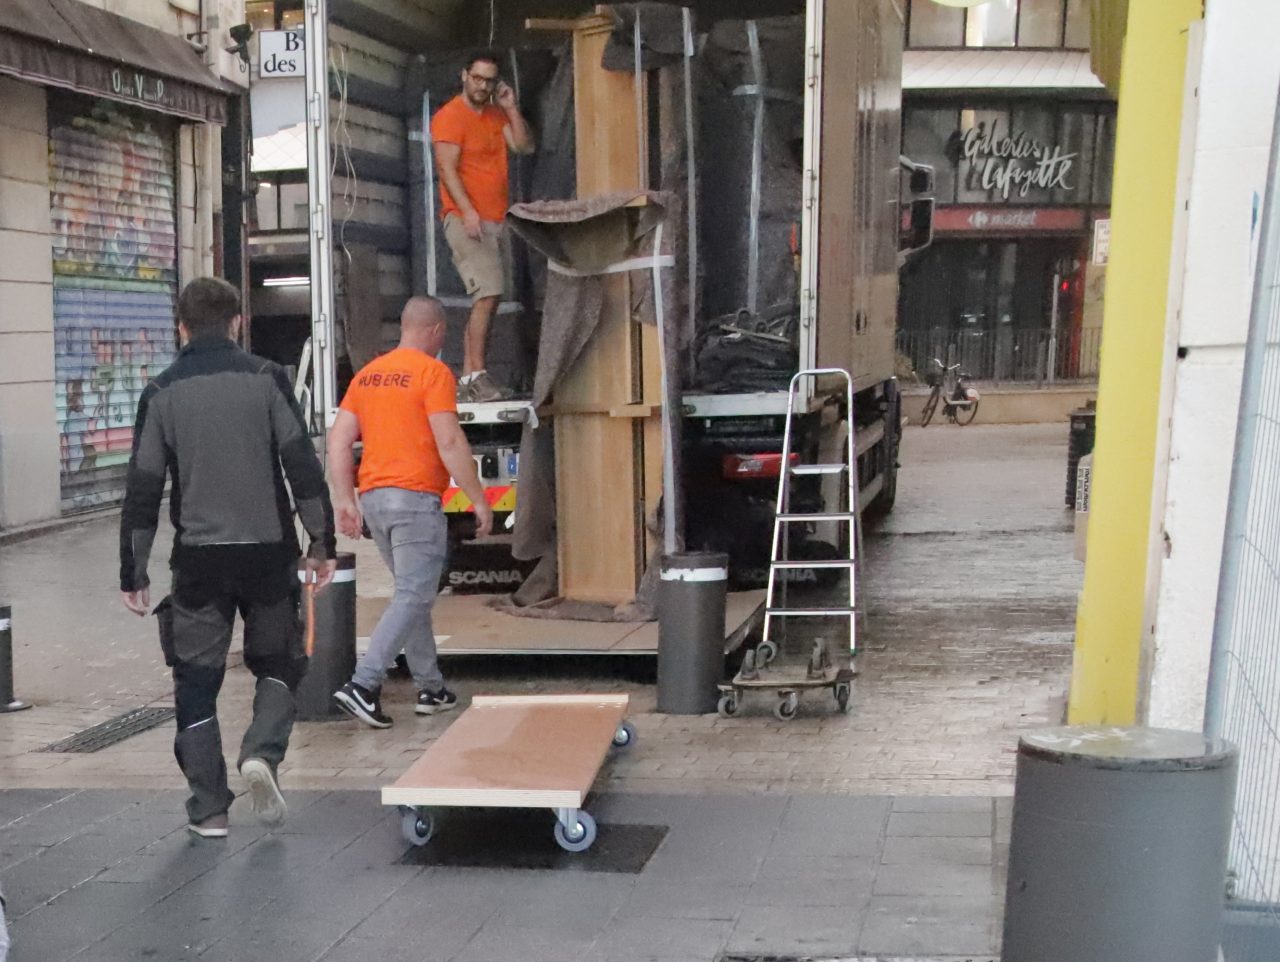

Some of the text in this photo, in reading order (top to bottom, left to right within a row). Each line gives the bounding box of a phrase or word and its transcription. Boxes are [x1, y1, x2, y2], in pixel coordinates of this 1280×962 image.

[264, 53, 296, 73] des
[982, 146, 1078, 199] Lafayette
[991, 211, 1038, 226] market
[448, 570, 523, 585] SCANIA
